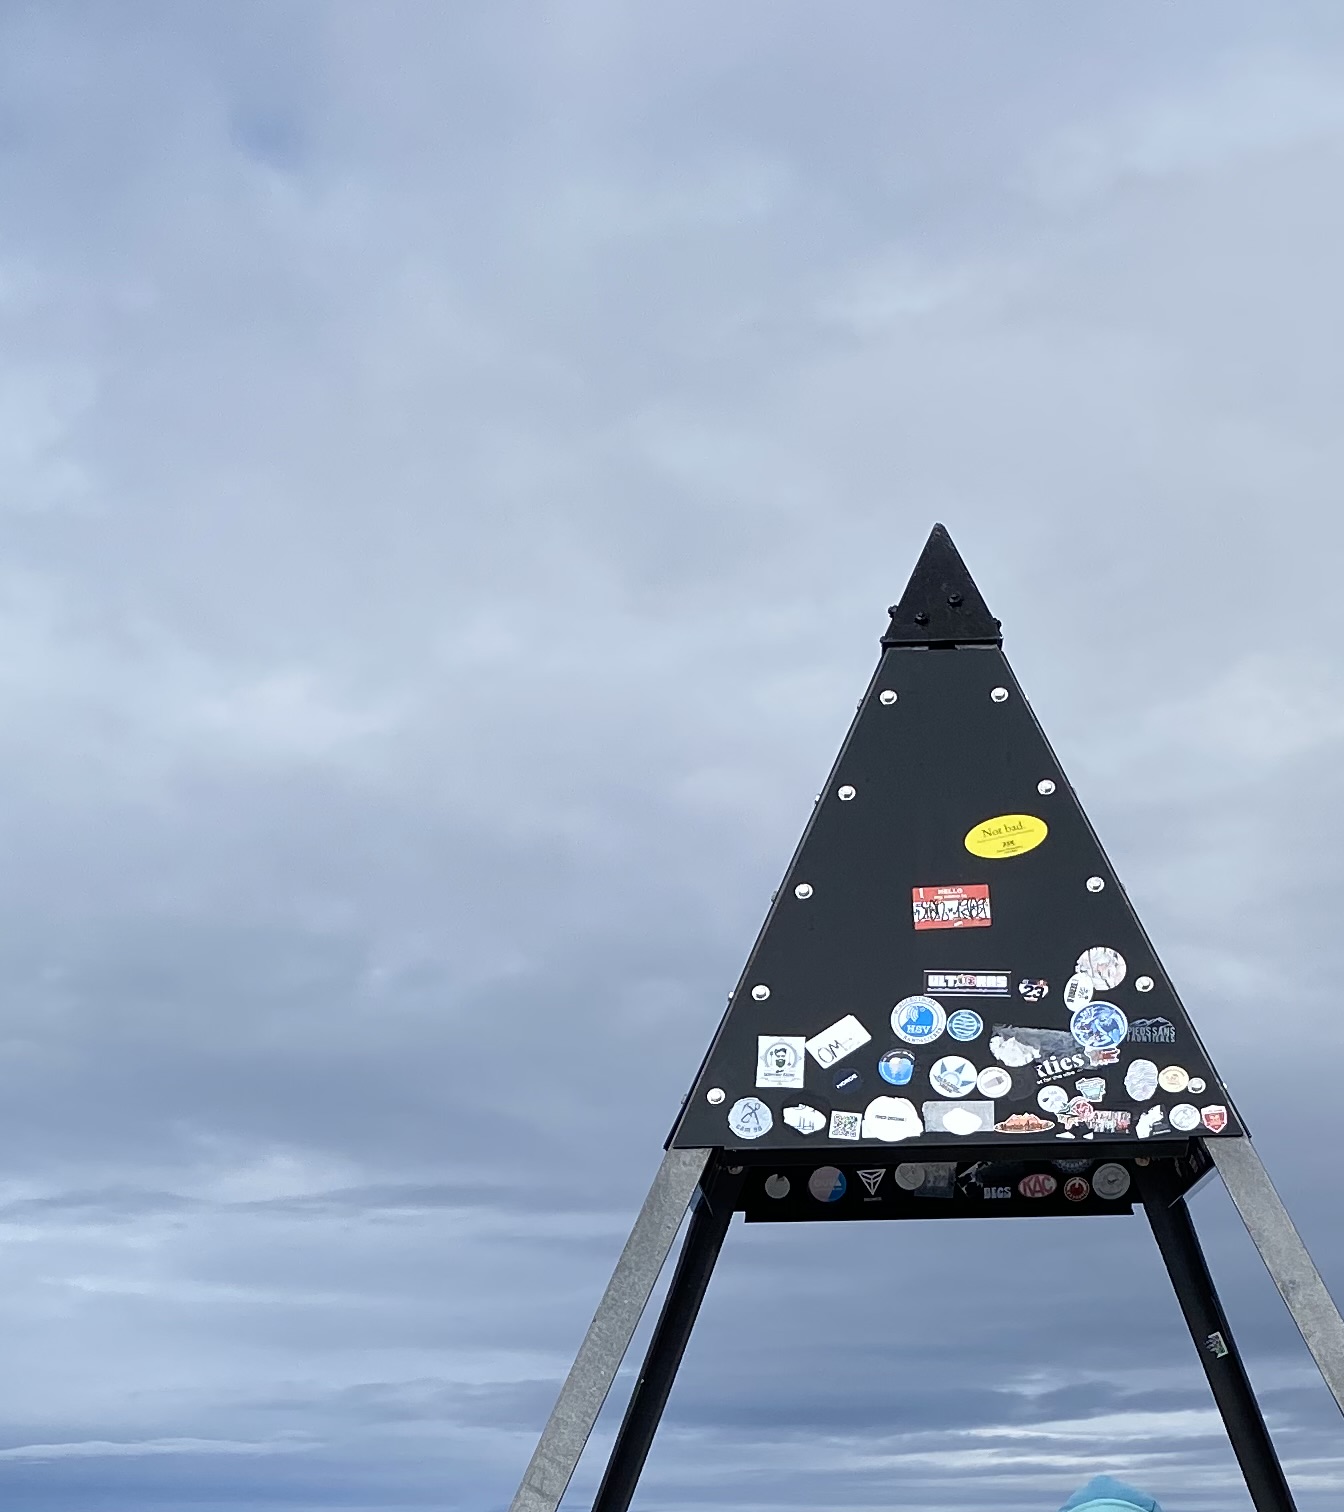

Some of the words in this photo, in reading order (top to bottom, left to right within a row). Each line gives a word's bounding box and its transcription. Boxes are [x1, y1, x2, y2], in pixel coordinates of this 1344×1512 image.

[981, 827, 1003, 838] Not
[937, 887, 963, 895] HELLO
[1023, 984, 1045, 998] 23
[906, 1023, 931, 1035] HSV
[1021, 1174, 1054, 1197] KAC
